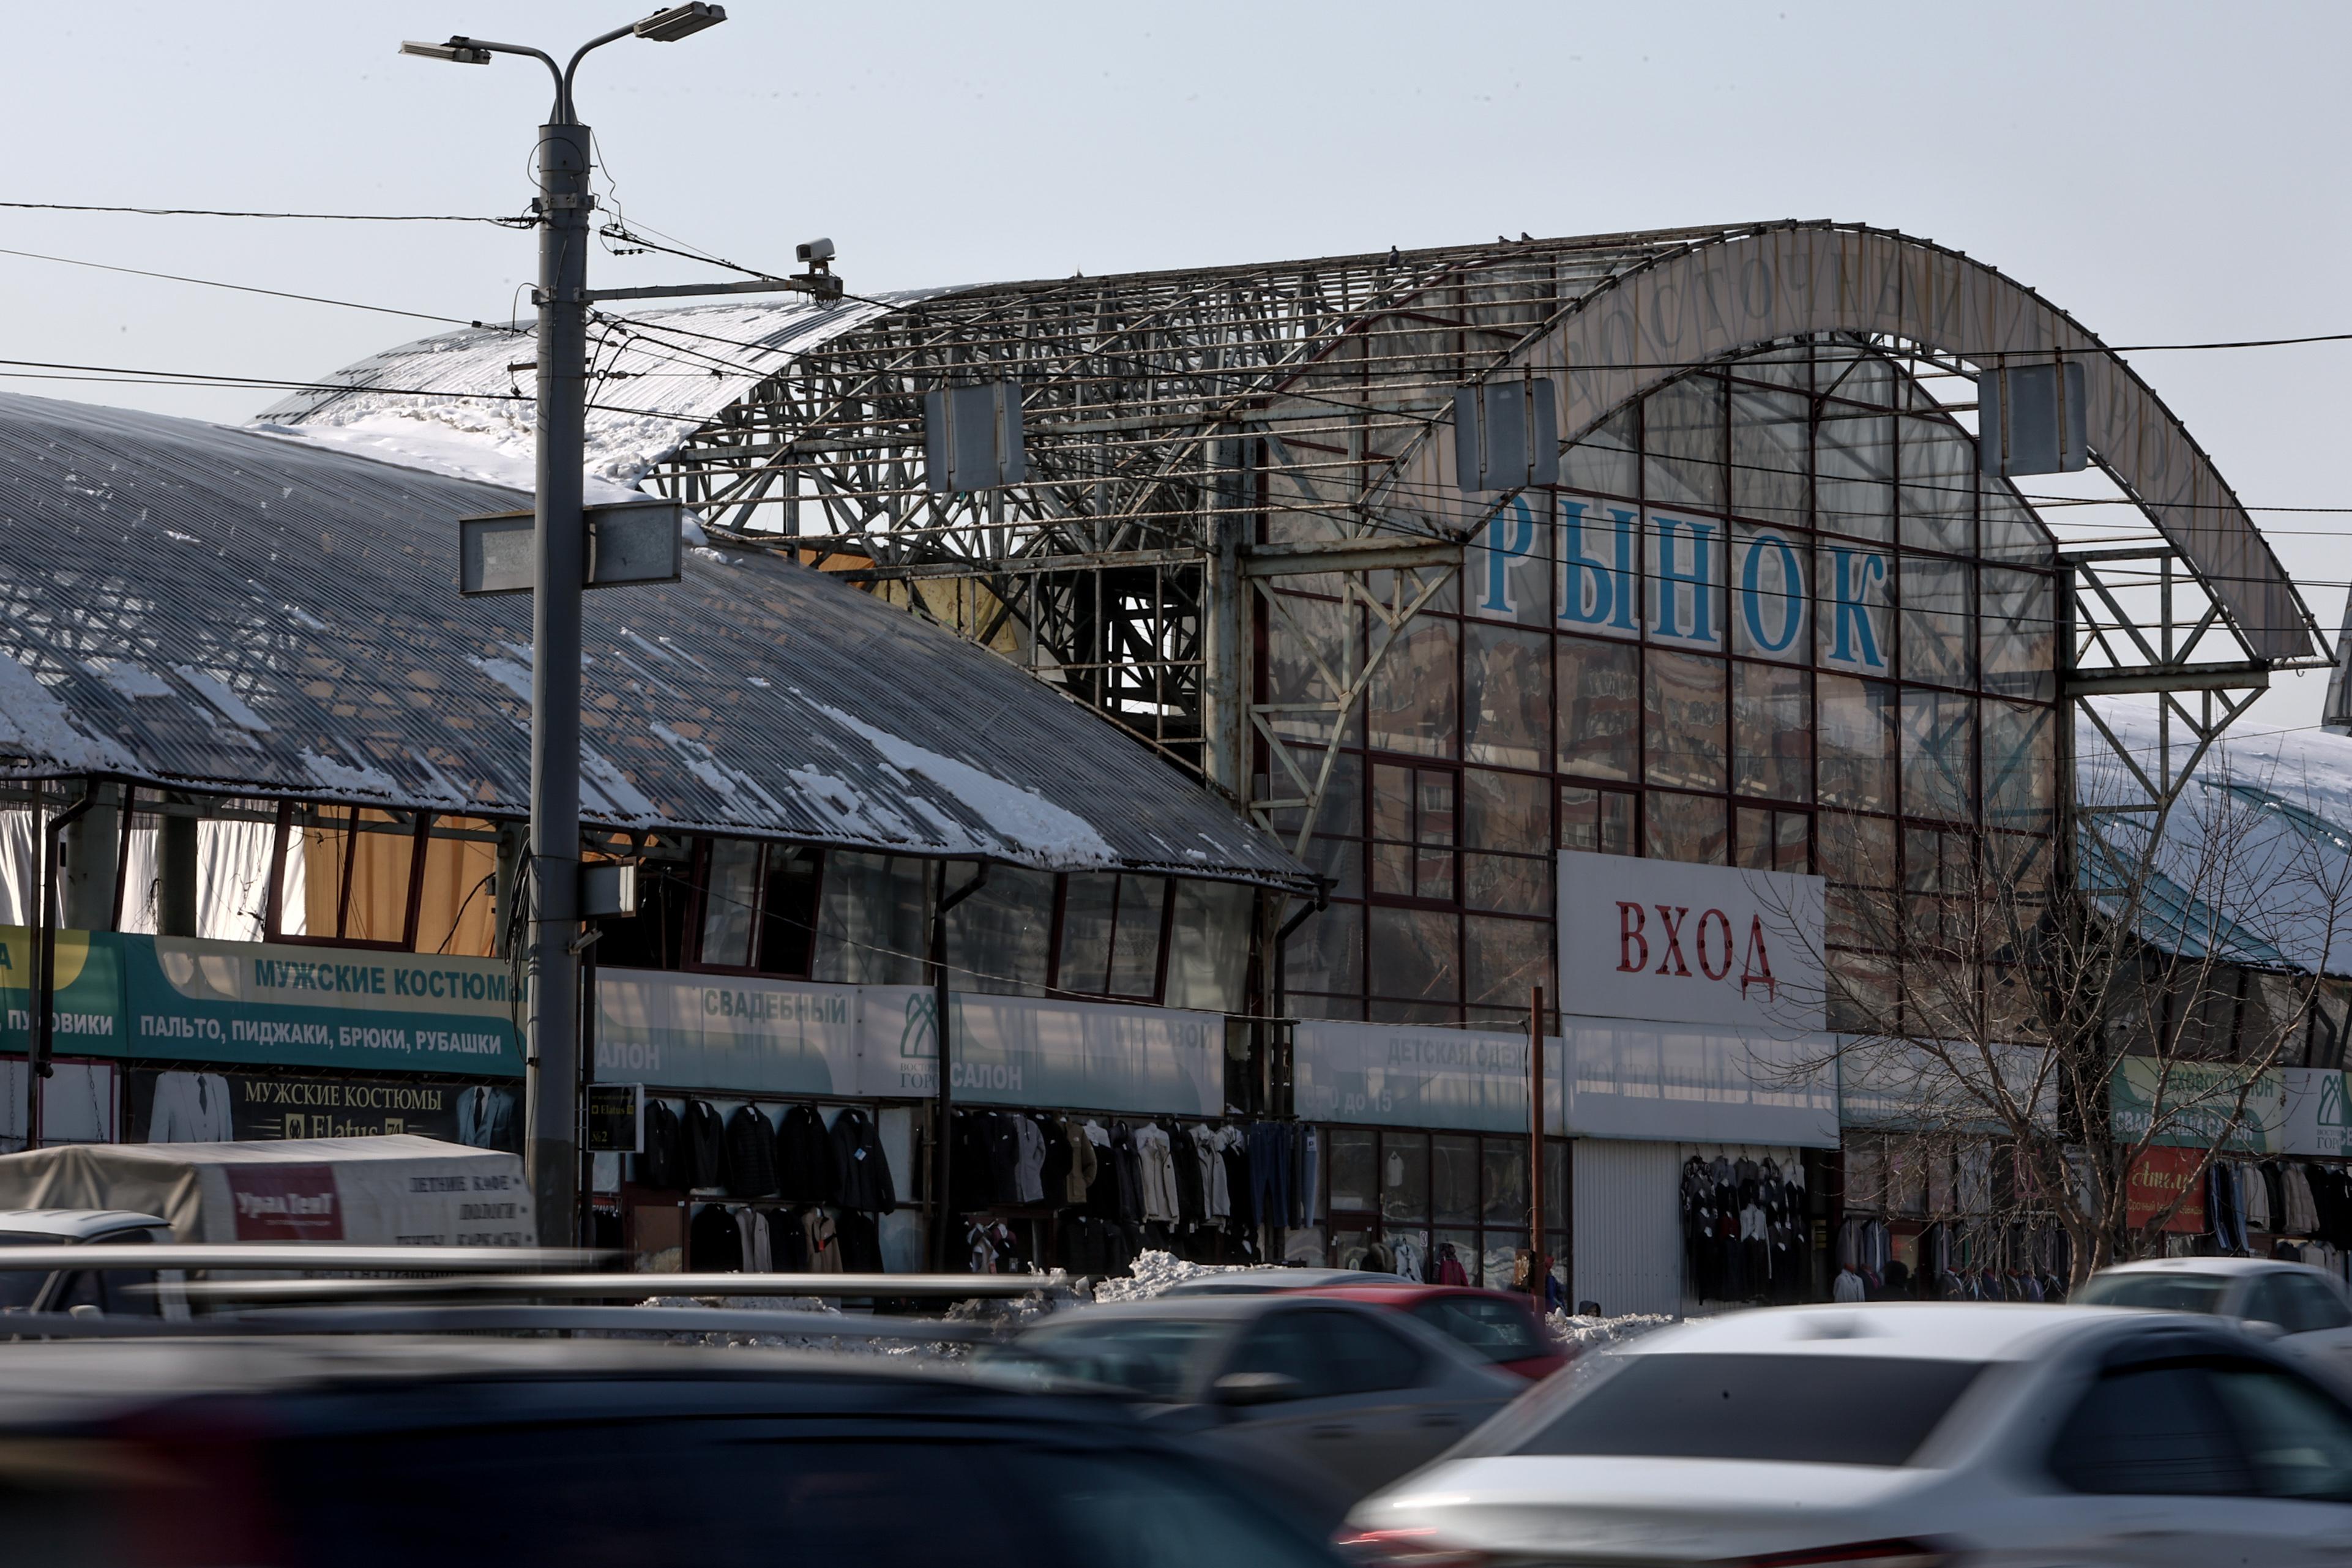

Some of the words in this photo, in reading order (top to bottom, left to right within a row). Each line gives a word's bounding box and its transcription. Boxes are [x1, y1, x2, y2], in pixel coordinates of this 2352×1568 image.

[1479, 493, 1887, 670] РЫНОК
[1615, 901, 1775, 1002] ВХОД
[254, 958, 386, 995] МУЖСКИЕ
[394, 968, 528, 1003] КОСТЮМЫ
[704, 988, 846, 1025] СВАДЕБНЫЙ
[7, 1009, 113, 1036] ПУОВИКИ
[141, 1015, 226, 1044] ПАЛЬТО,
[232, 1020, 334, 1050] ПИДЖАКИ,
[339, 1026, 411, 1054] БРЮКИ,
[416, 1031, 501, 1055] РУБАШКИ
[596, 1041, 660, 1070] АЛОН
[1387, 1037, 1471, 1066] ДЕТСКАЯ
[949, 1062, 1022, 1091] САЛОН
[244, 1081, 340, 1107] МУЖСКИЕ
[344, 1086, 442, 1111] КОСТЮМЫ
[1344, 1094, 1365, 1115] до
[1373, 1089, 1392, 1113] 15
[311, 1114, 378, 1139] Elatus
